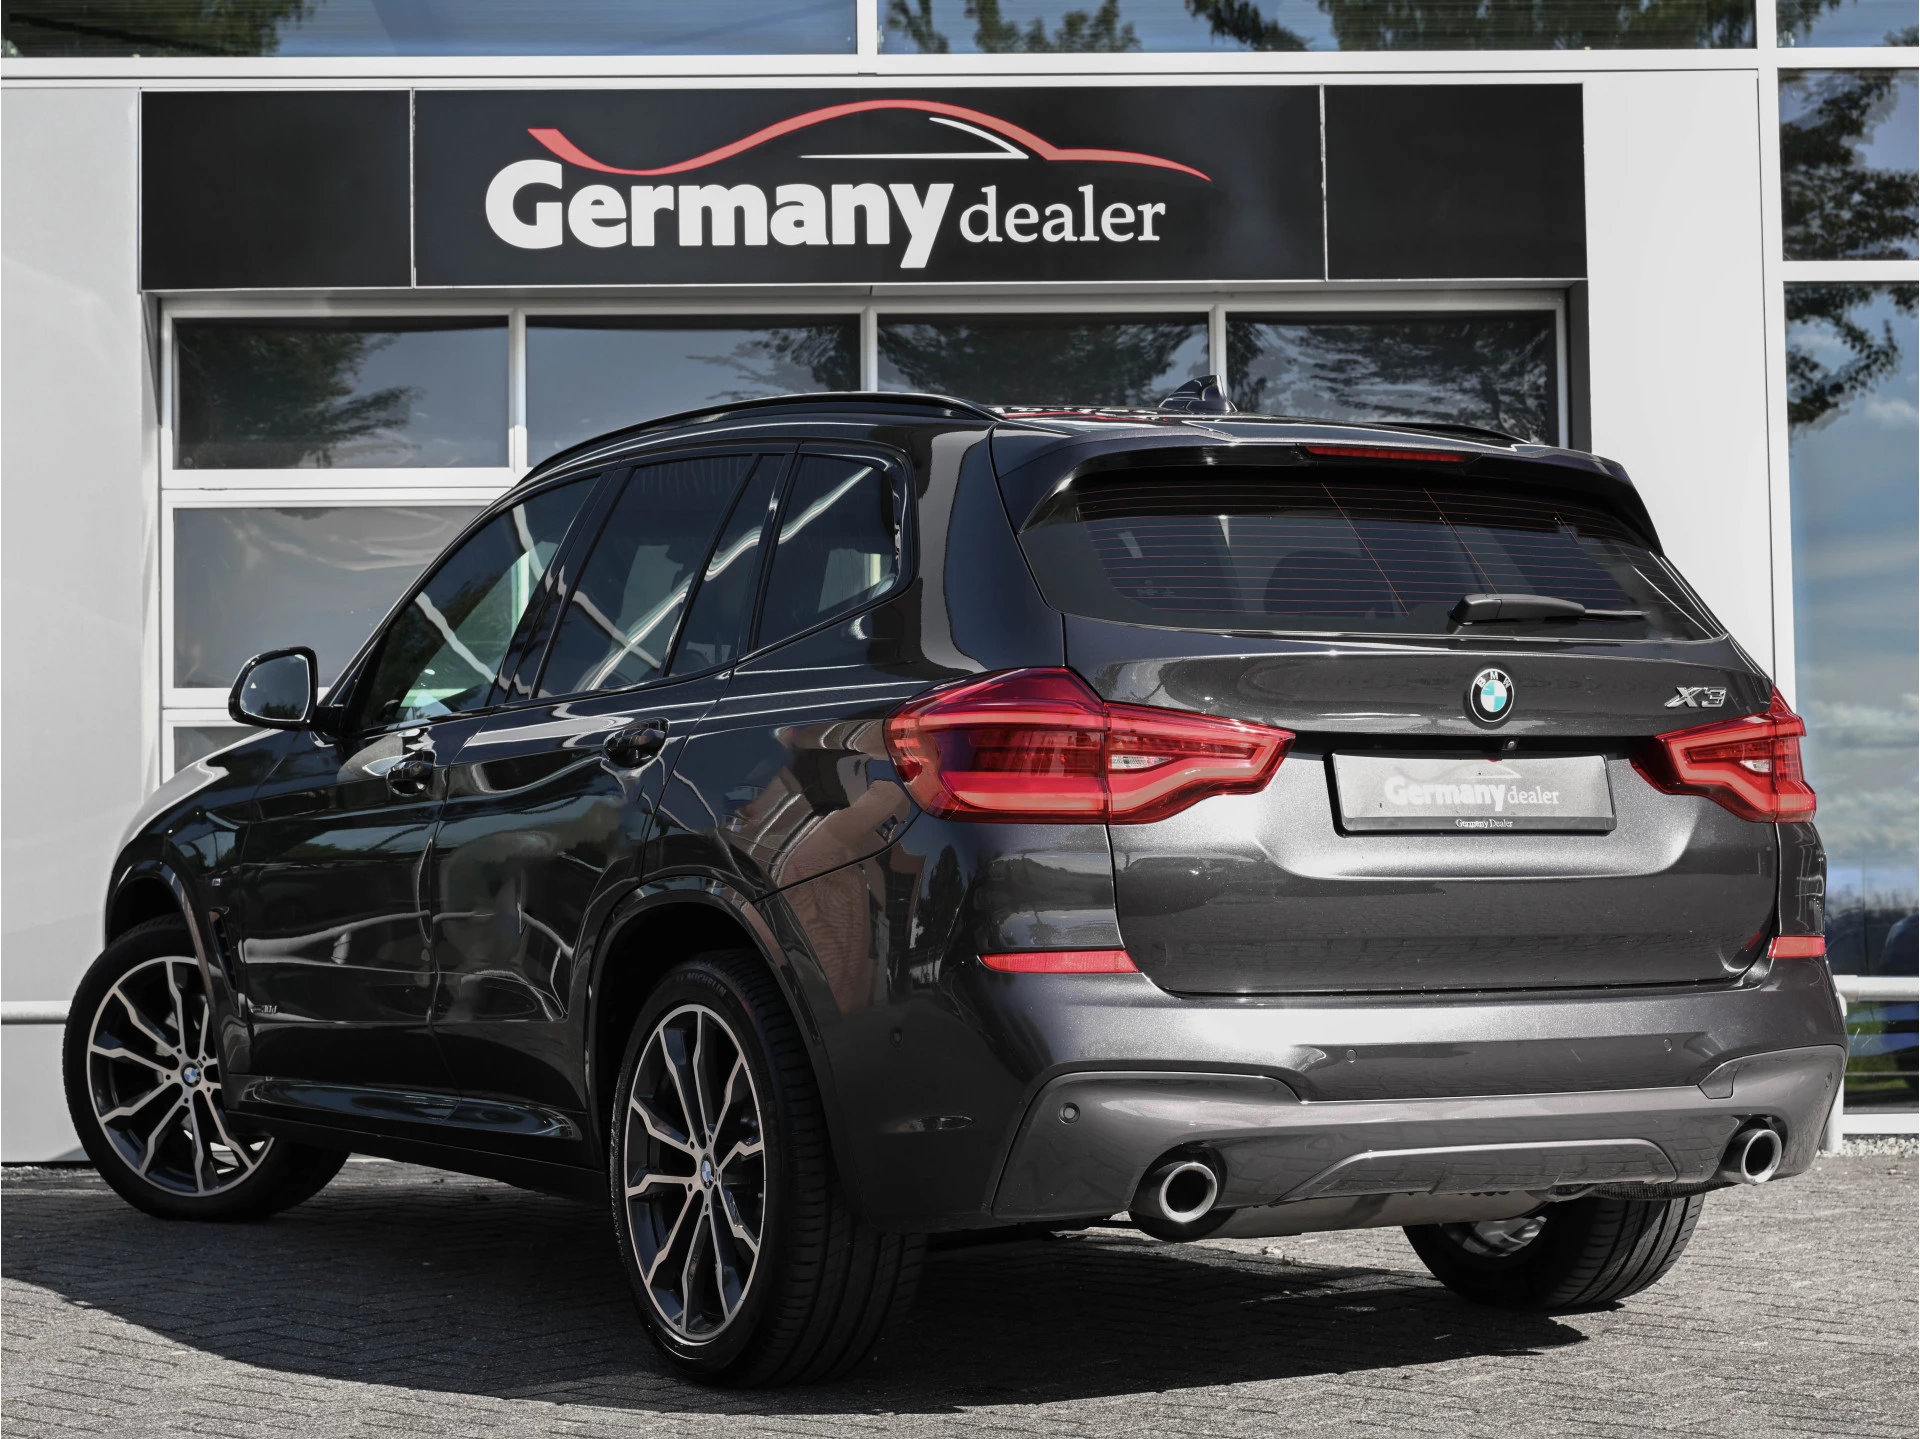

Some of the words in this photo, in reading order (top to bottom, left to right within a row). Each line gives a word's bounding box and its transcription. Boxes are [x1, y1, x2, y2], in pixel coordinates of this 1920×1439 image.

[485, 159, 953, 268] Germany
[959, 185, 1166, 243] dealer
[1476, 670, 1511, 689] BMW
[1664, 686, 1727, 708] X3
[1384, 776, 1506, 812] Germany
[1507, 785, 1560, 805] dealer
[1455, 818, 1489, 829] Germany
[1489, 818, 1513, 828] Dealer
[687, 972, 728, 997] MICHELIN
